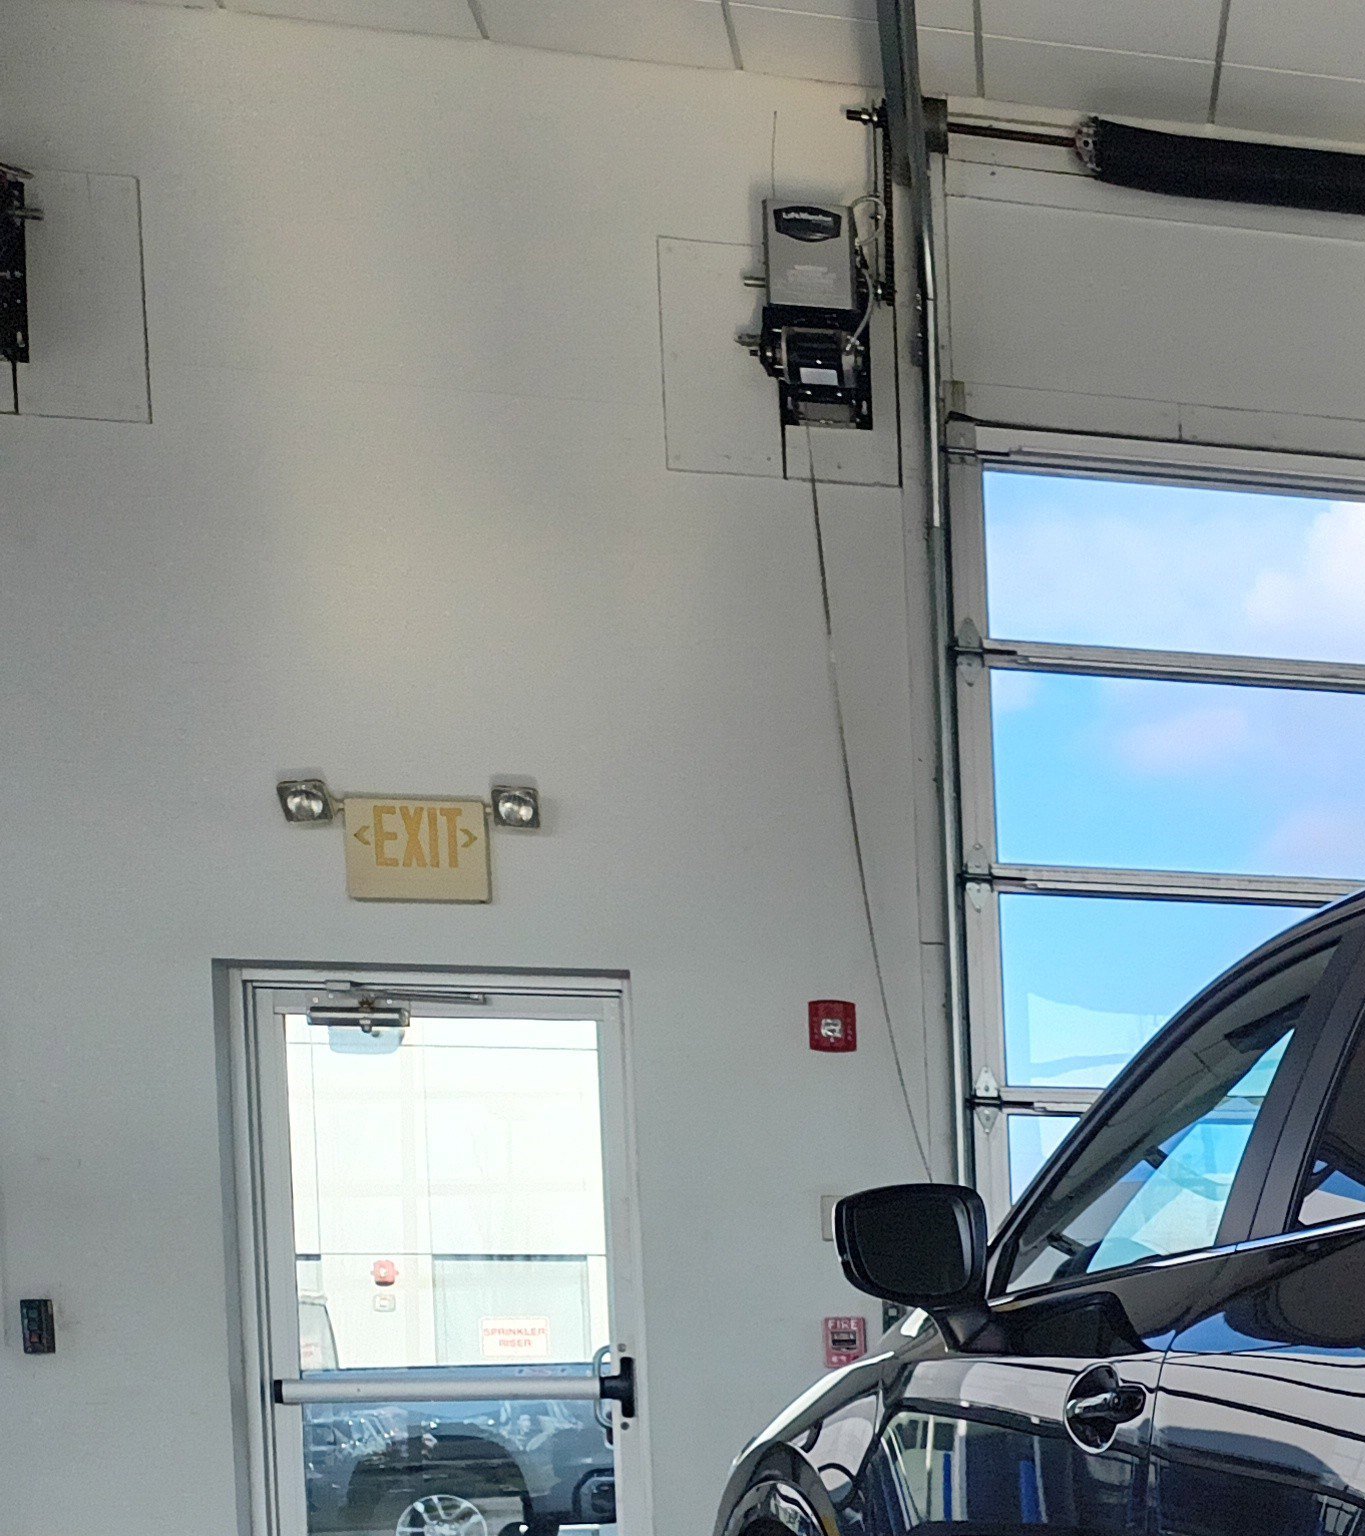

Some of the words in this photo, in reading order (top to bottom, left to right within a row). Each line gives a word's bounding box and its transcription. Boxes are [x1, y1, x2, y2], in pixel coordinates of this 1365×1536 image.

[373, 805, 462, 868] EXIT
[827, 1318, 859, 1330] FIRE
[483, 1327, 547, 1337] SPRINKLER
[498, 1338, 532, 1348] RISER
